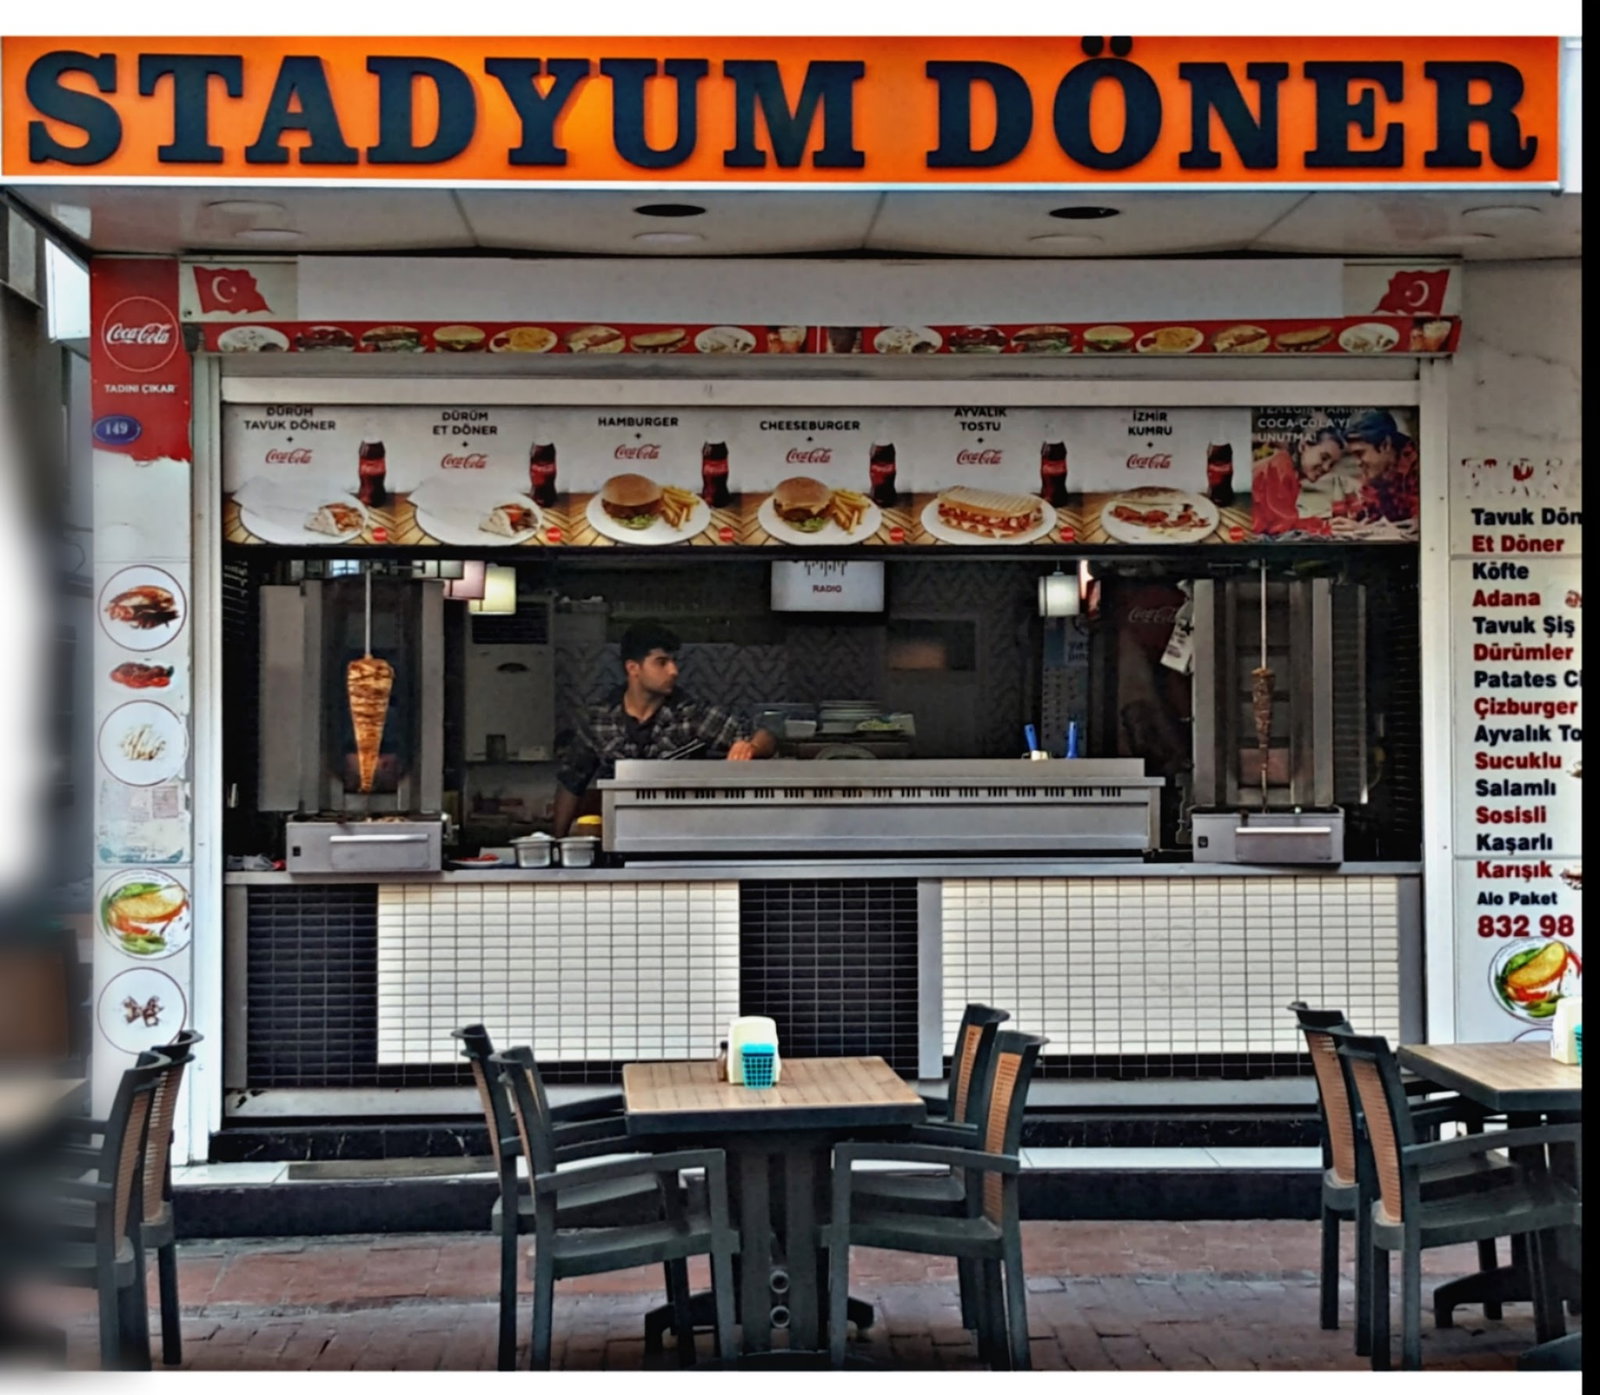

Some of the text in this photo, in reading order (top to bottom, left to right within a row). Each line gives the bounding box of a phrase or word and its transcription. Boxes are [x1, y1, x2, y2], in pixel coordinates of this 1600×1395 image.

[25, 36, 1538, 170] STADYUM DÖNER
[105, 384, 175, 395] TADINI ÇIKAR
[441, 410, 489, 422] DÜRÜM
[954, 406, 1008, 418] AYVALIK
[1132, 410, 1168, 422] İZMİR
[105, 421, 129, 436] 149
[244, 418, 336, 431] TAVUK DÖNER
[432, 422, 498, 436] ET DÖNER
[598, 416, 679, 428] HAMBURGER
[759, 420, 861, 432] CHEESEBURGER
[960, 421, 1001, 432] TOSTU
[1128, 425, 1173, 437] KUMRU
[1471, 508, 1535, 525] Tavuk
[1472, 534, 1565, 552] Et Döner
[1473, 562, 1530, 580] Köfte
[812, 585, 842, 593] RADIO
[1472, 589, 1541, 608] Adana
[1473, 615, 1575, 638] Tavuk Şiş
[1474, 643, 1574, 662] Dürümler
[1474, 670, 1557, 688] Patates
[1474, 697, 1578, 720] Çizburger
[1474, 724, 1551, 747] Ayvalık
[1475, 751, 1562, 770] Sucuklu
[1475, 779, 1556, 797] Salamlı
[1476, 805, 1547, 825] Sosisli
[1476, 833, 1553, 856] Kaşarlı
[1476, 860, 1553, 883] Karışık
[1477, 891, 1558, 906] Alo Paket
[1477, 914, 1575, 939] 832 98
